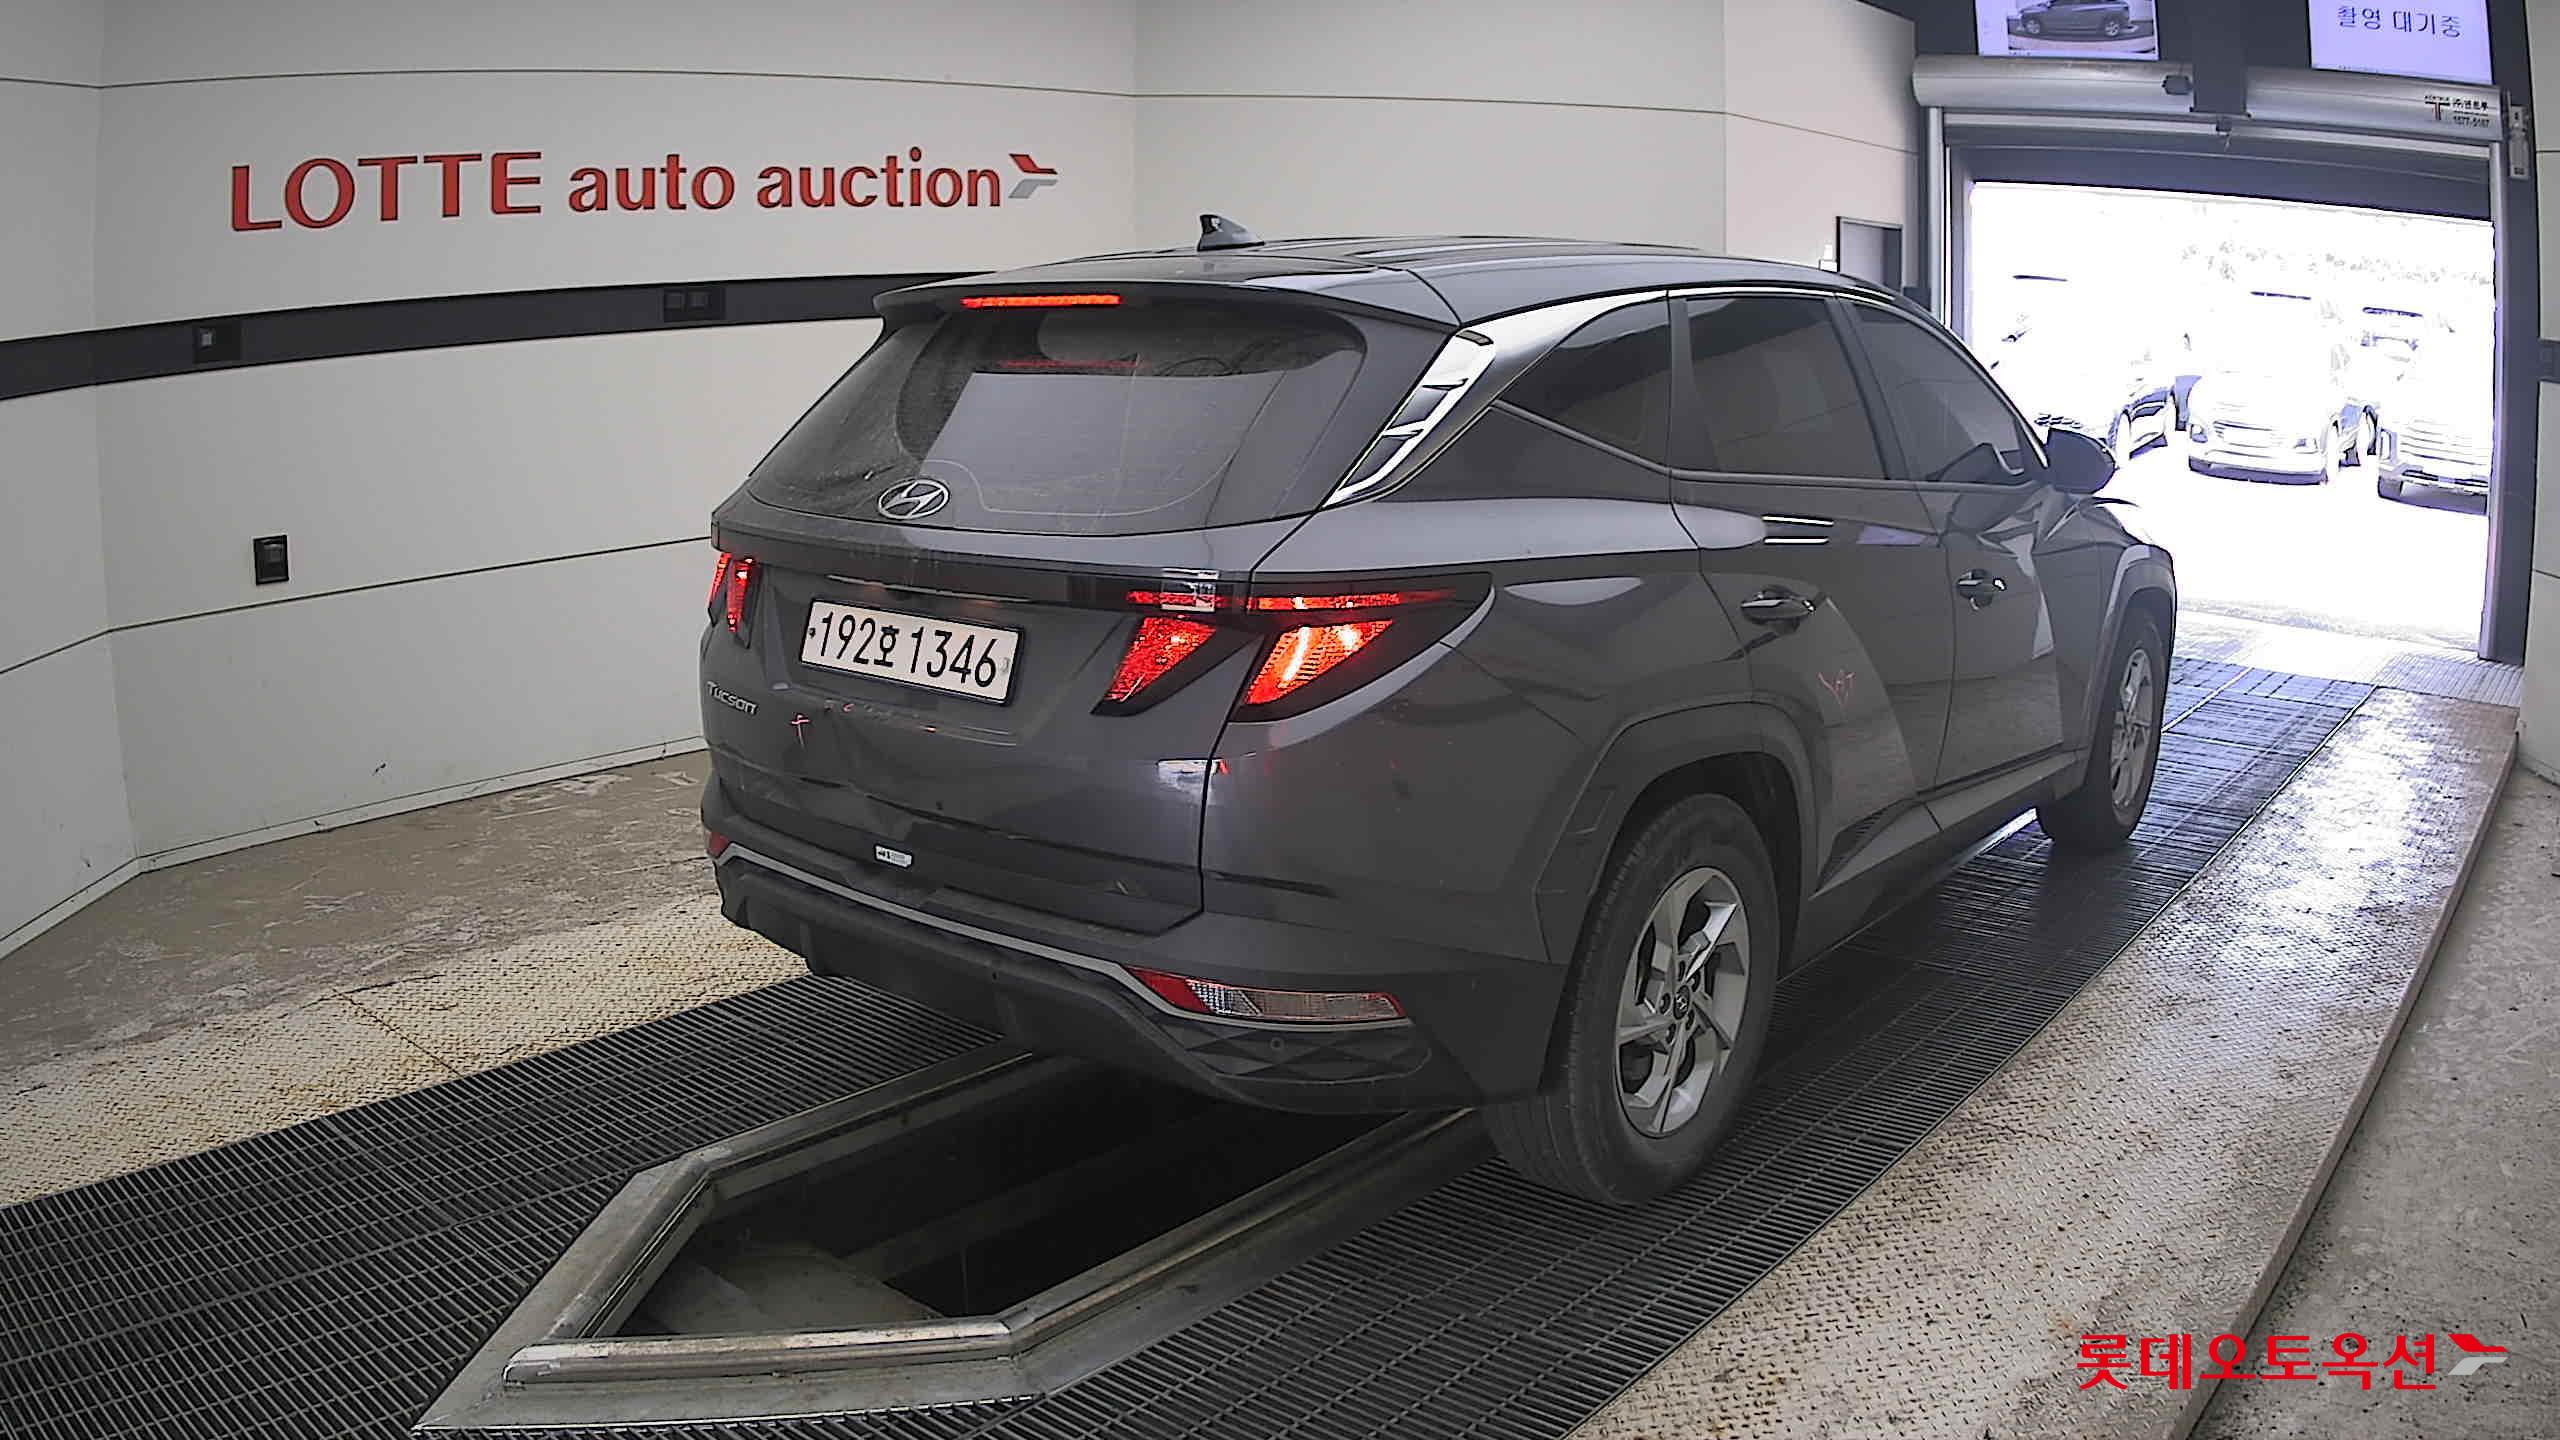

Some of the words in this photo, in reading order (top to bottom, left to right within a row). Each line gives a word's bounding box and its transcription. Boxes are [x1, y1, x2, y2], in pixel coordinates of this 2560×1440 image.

[2338, 6, 2381, 31] 촬영
[2392, 10, 2462, 38] 대기중
[231, 151, 542, 232] LOTTE
[567, 153, 736, 213] auto
[756, 146, 1001, 208] auction
[820, 611, 900, 667] 192호
[910, 626, 997, 688] 1346
